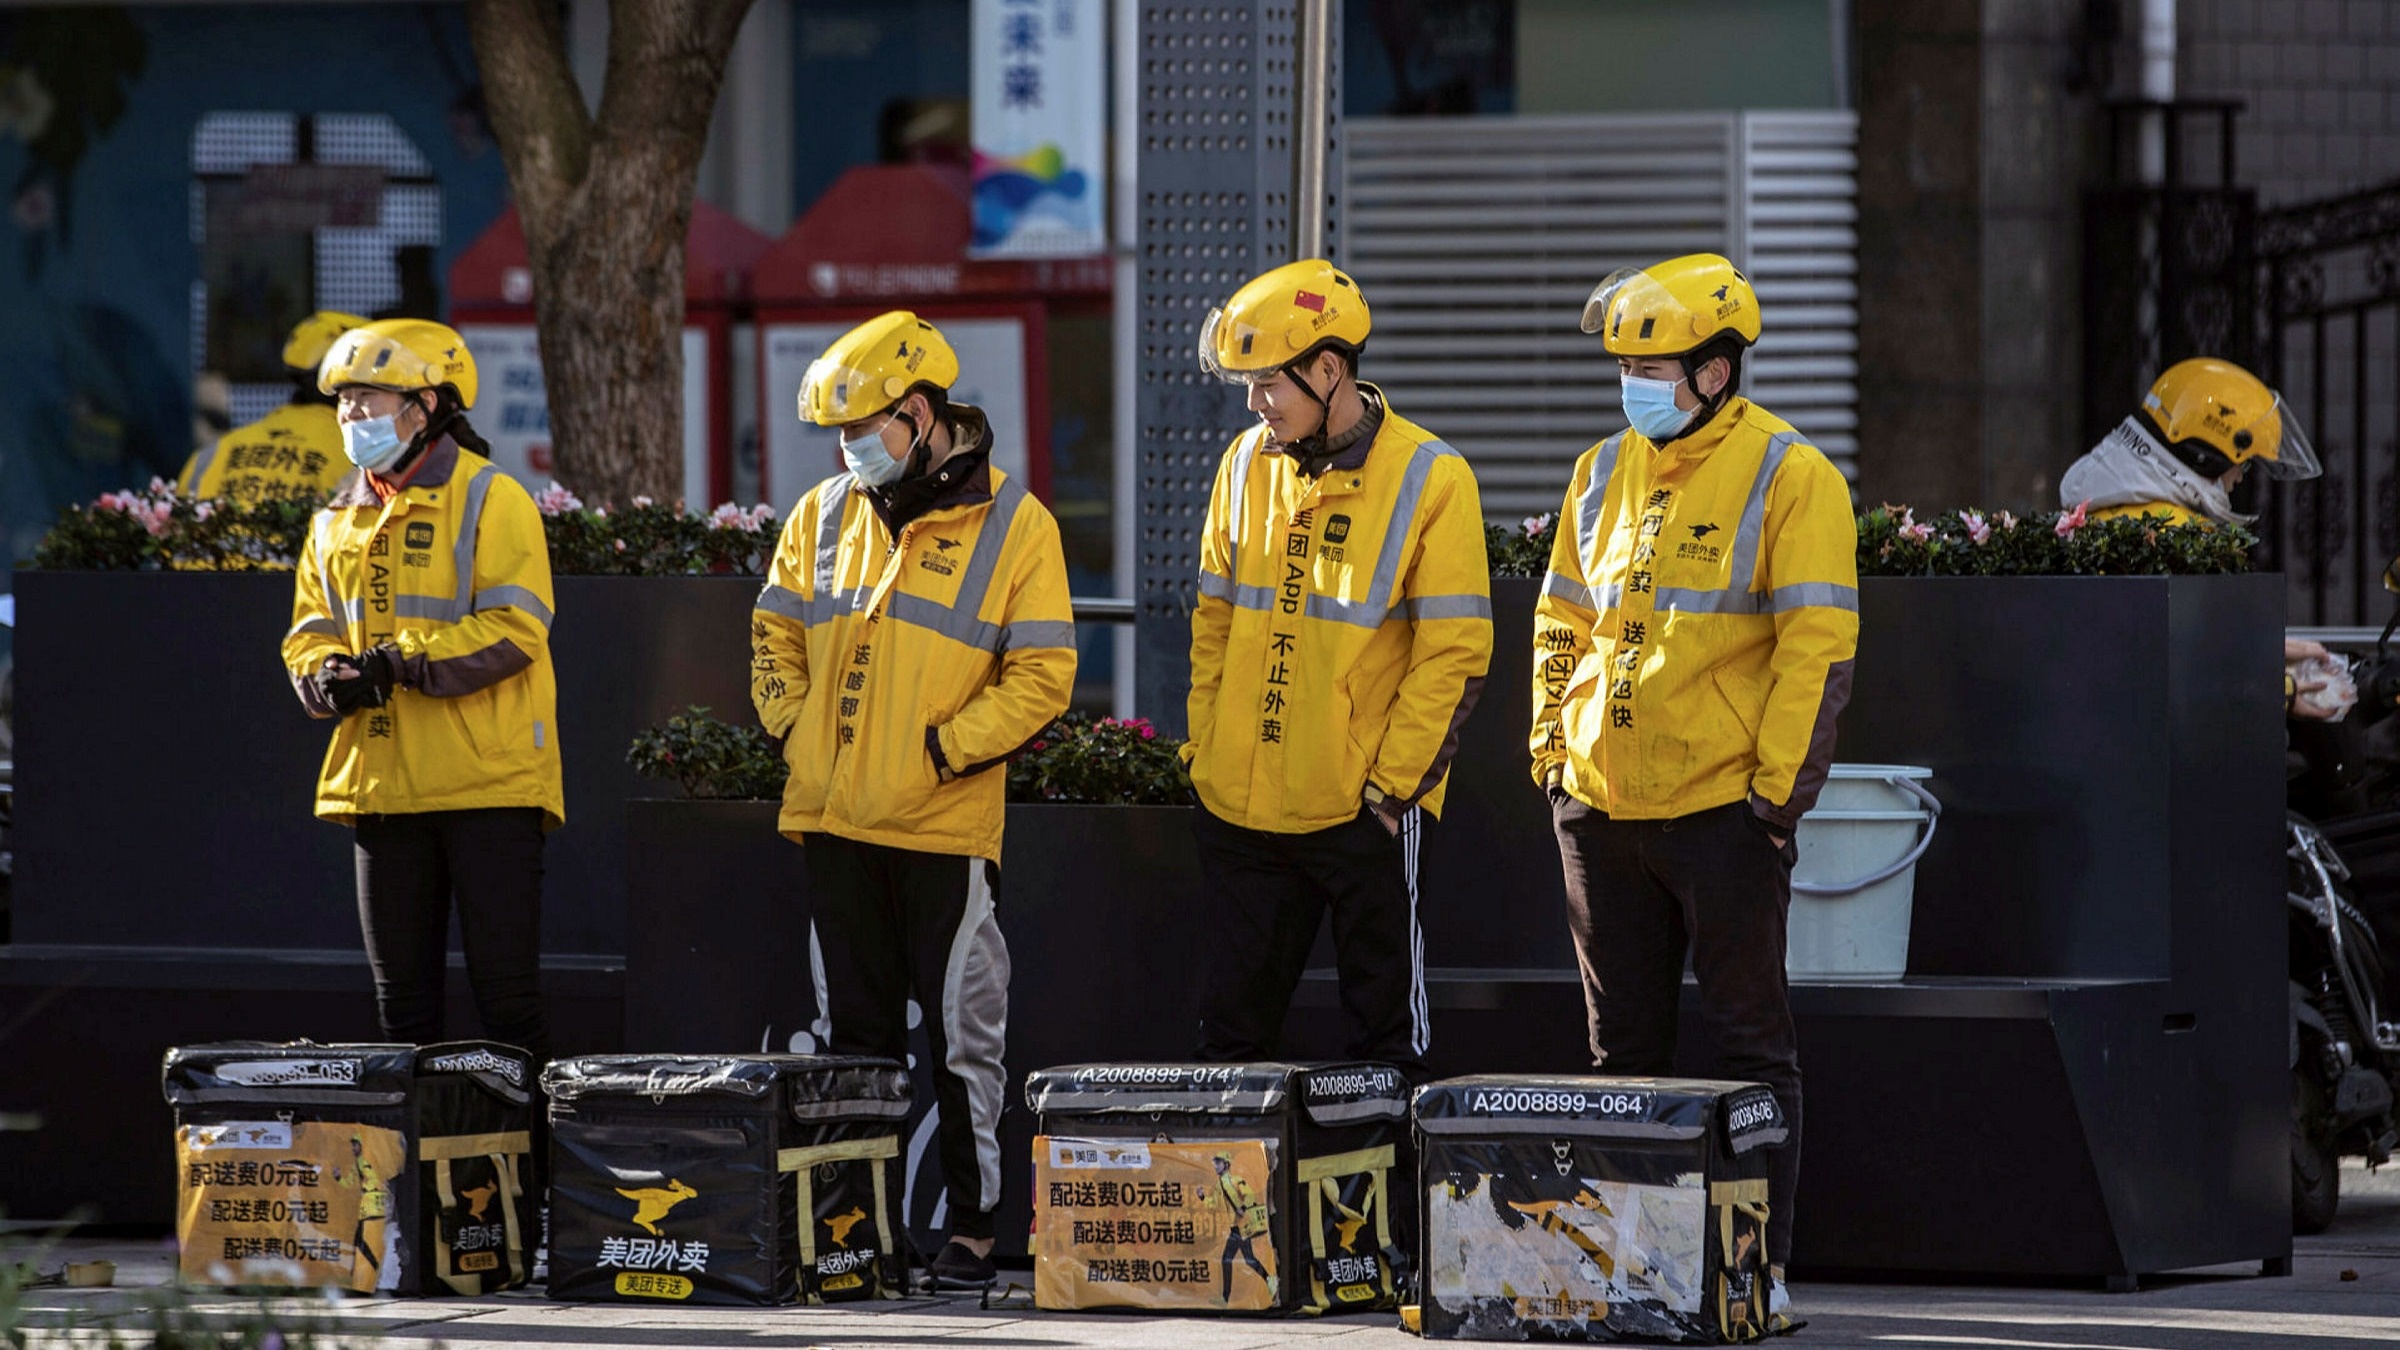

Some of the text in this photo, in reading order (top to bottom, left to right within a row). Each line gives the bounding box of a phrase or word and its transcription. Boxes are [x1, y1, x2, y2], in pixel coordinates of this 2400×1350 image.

[227, 445, 328, 475] 美团外卖
[1610, 489, 1673, 729] 美团外卖 送花也快
[840, 644, 871, 744] 送啥都快
[1261, 632, 1296, 744] 不止外卖
[1309, 1073, 1395, 1096] A2008899-074
[1473, 1091, 1643, 1114] A2008899-064
[1075, 1150, 1098, 1163] 美团
[190, 1161, 319, 1188] 配送费0元起
[1050, 1181, 1183, 1208] 配送费0元起
[211, 1200, 329, 1224] 配送费0元起
[452, 1223, 503, 1250] 美团外卖
[1073, 1220, 1194, 1245] 配送费0元起
[224, 1237, 342, 1261] 配送费0元起
[597, 1236, 710, 1272] 美团外卖
[1087, 1260, 1210, 1283] 配送费0元起
[1328, 1256, 1378, 1284] 美团外卖
[624, 1275, 683, 1294] 美团专送
